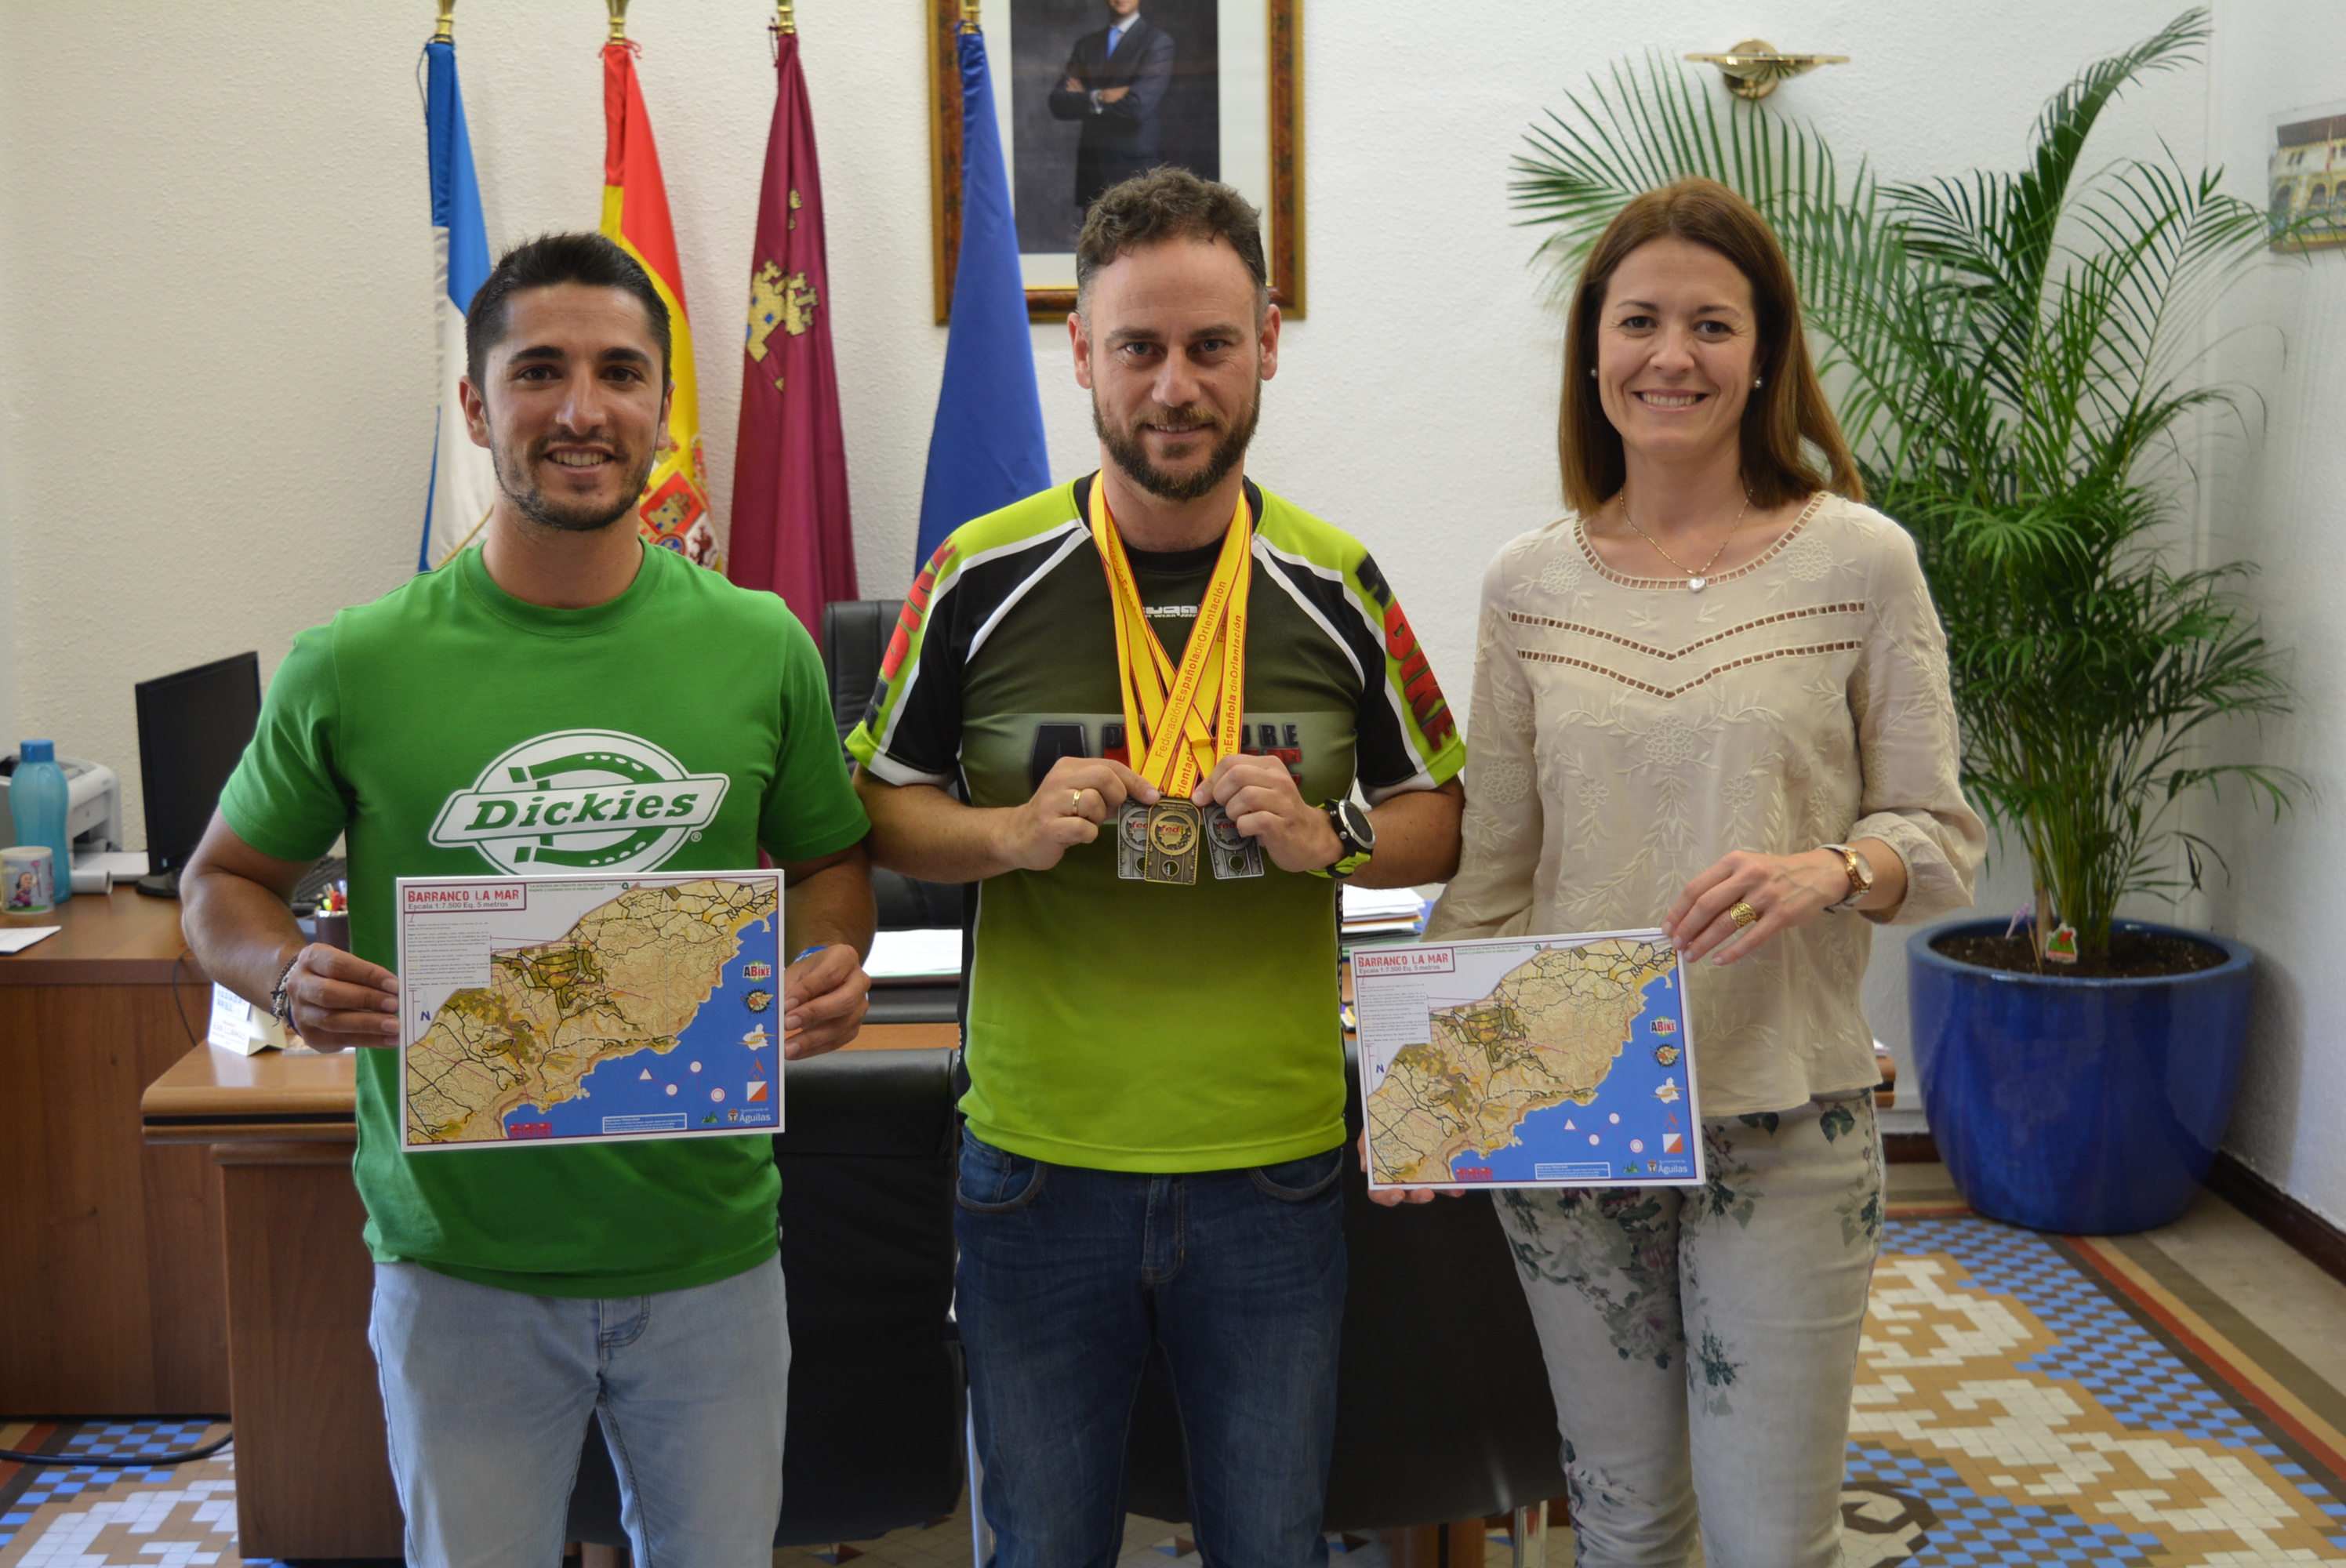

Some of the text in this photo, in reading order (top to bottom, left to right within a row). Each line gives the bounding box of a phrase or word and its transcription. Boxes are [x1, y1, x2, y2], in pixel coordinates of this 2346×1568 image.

[463, 789, 699, 832] Dickies
[408, 889, 520, 902] BARRANCO LA MAR
[1358, 953, 1448, 967] BARRANCO LA MAR
[420, 1011, 431, 1021] N
[1376, 1064, 1385, 1073] N
[739, 1112, 771, 1123] Águilas
[1658, 1163, 1688, 1175] Águilas
